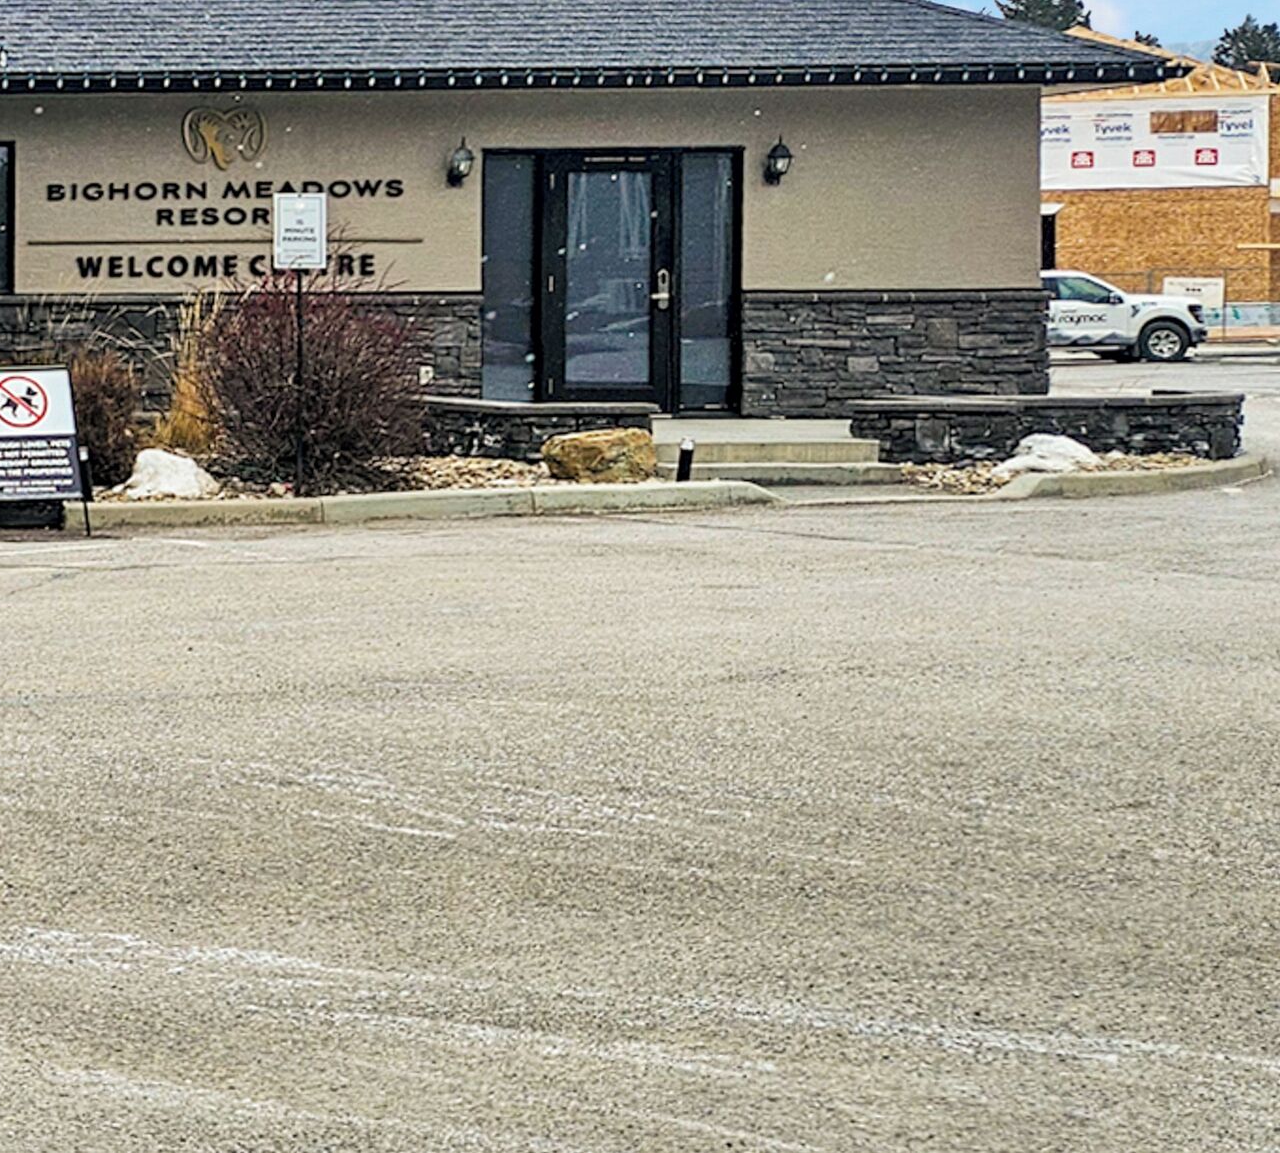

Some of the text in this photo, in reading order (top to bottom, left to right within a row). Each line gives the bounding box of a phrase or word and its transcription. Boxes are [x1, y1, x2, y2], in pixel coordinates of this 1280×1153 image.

[1094, 123, 1133, 135] Tyvek
[45, 179, 404, 202] BIGHORN MEADOWS
[156, 206, 269, 226] RESOR
[76, 255, 237, 278] WELCOME
